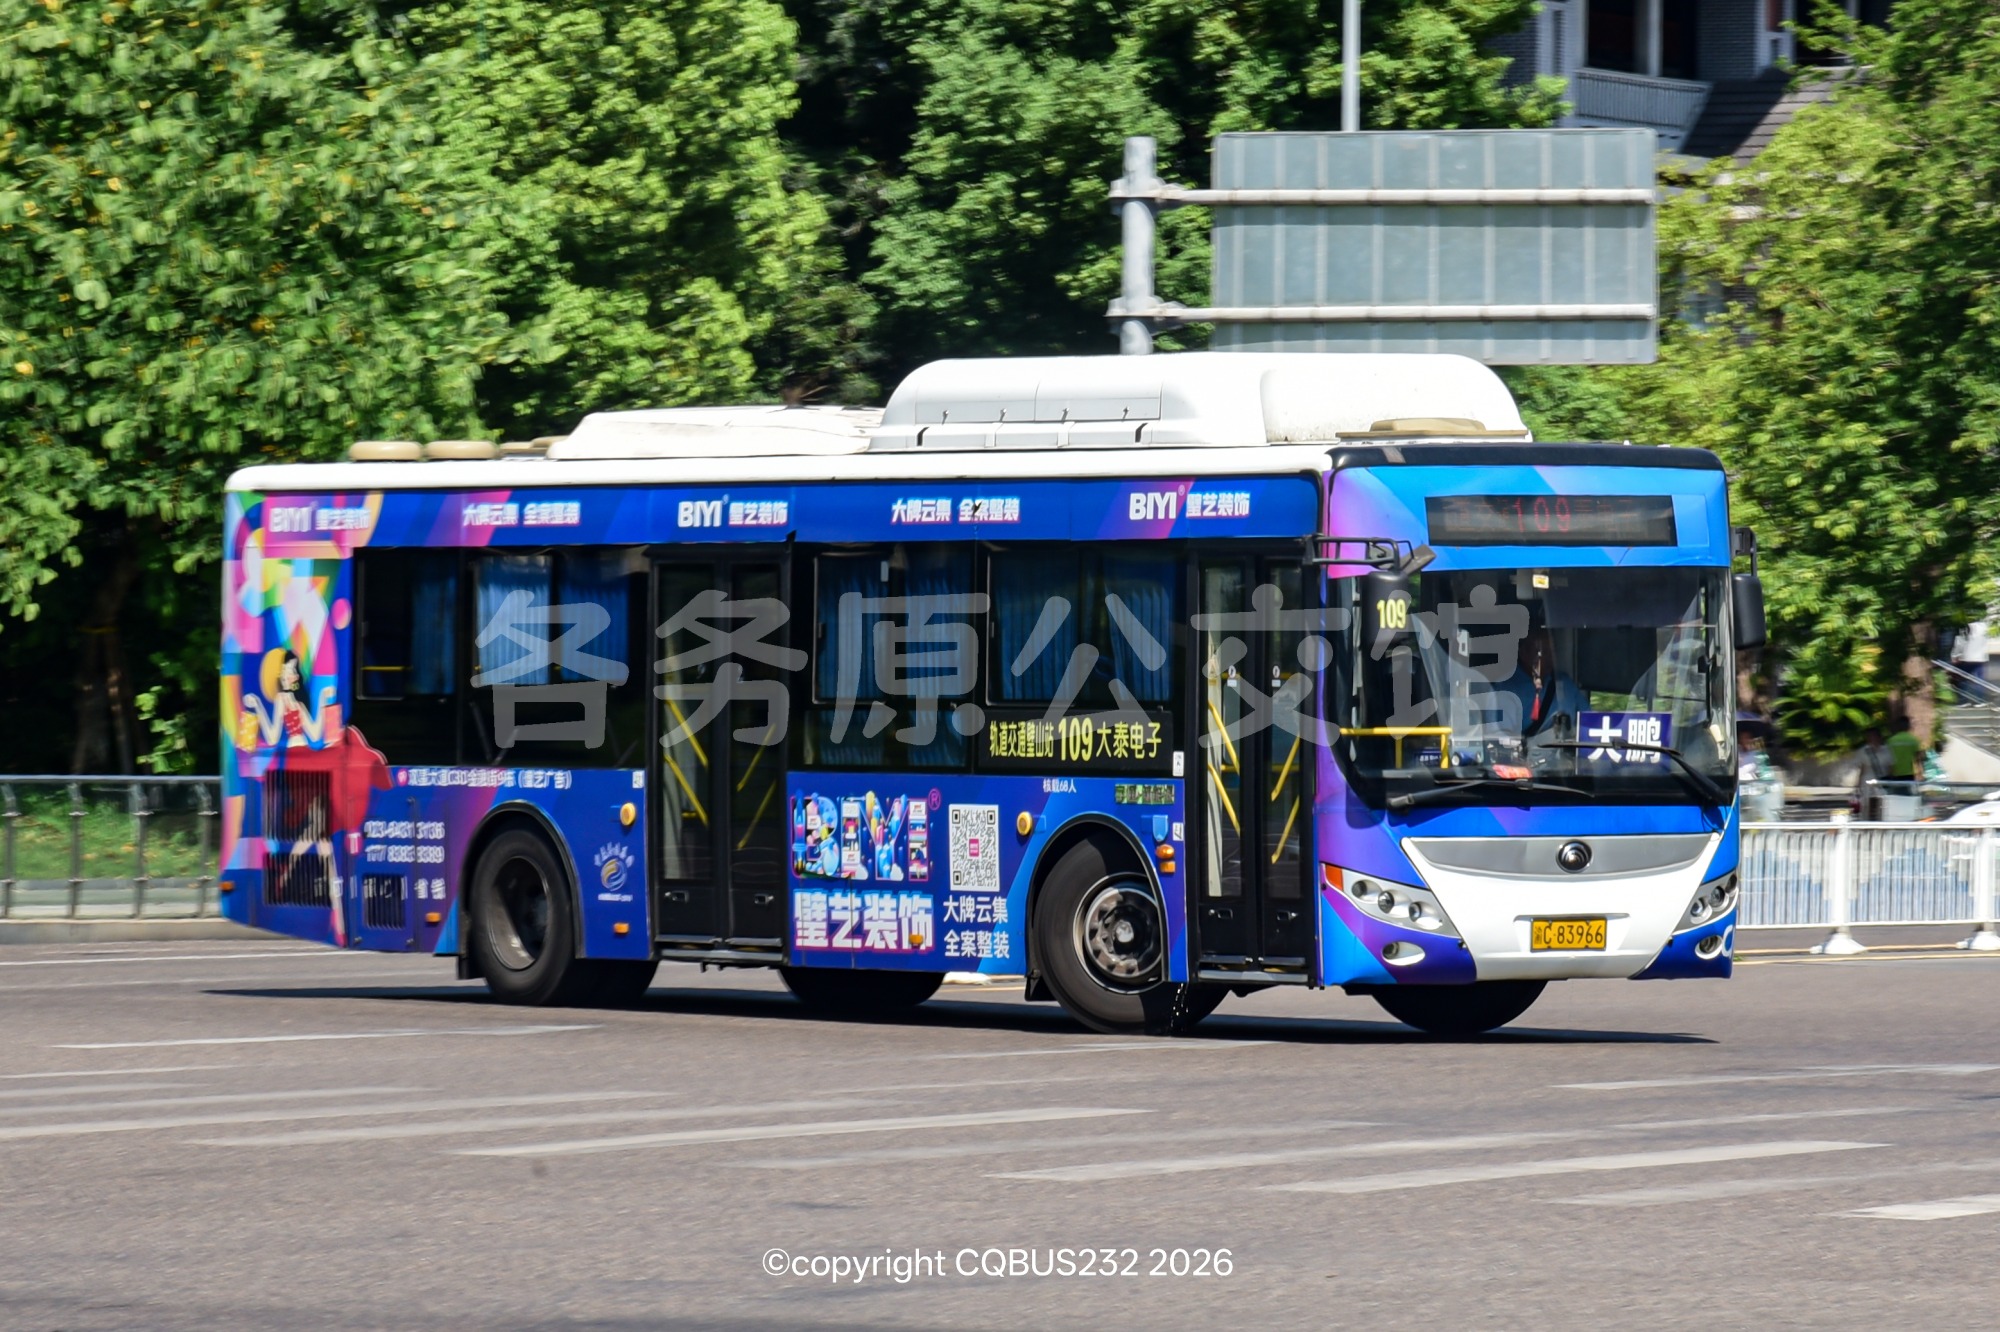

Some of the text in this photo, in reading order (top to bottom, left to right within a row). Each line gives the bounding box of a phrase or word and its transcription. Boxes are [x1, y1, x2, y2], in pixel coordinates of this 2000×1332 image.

[678, 501, 722, 527] BIYI
[892, 498, 1020, 523] 大牌云集 全案整装
[1129, 492, 1177, 520] BIYI
[1513, 497, 1571, 533] 109
[1376, 598, 1406, 629] 109
[1058, 717, 1094, 761] 109
[1096, 721, 1162, 759] 大泰电子
[1587, 715, 1662, 764] 大鹏
[790, 795, 929, 881] BIYI
[943, 895, 1008, 924] 大牌云集
[944, 929, 1010, 959] 全案整装
